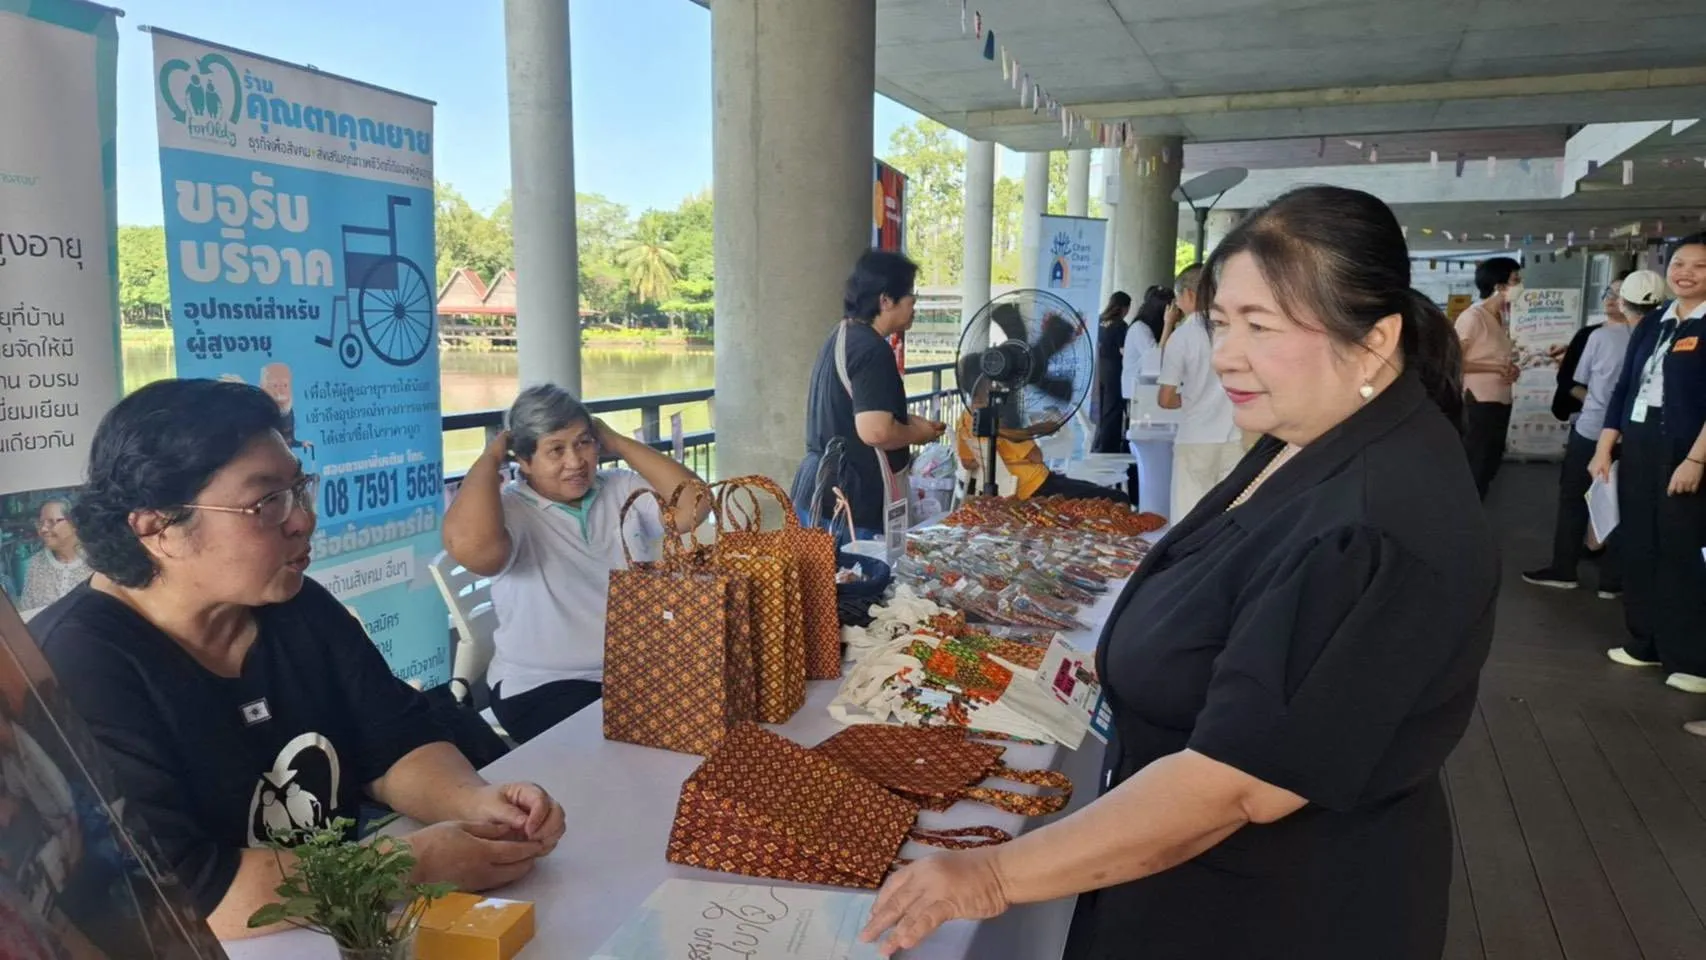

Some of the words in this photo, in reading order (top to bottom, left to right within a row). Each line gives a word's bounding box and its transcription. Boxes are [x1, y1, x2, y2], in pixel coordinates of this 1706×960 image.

[244, 68, 273, 94] ร้าน
[247, 93, 431, 155] คุณตาคุณยาย
[175, 171, 309, 233] ขอรับ
[180, 227, 334, 287] บริจาค
[184, 296, 320, 326] อุปกรณ์สำหรับ
[186, 328, 272, 360] ผู้สูงอายุ
[28, 373, 79, 388] อบรม
[324, 477, 349, 518] 08
[354, 468, 398, 512] 7591
